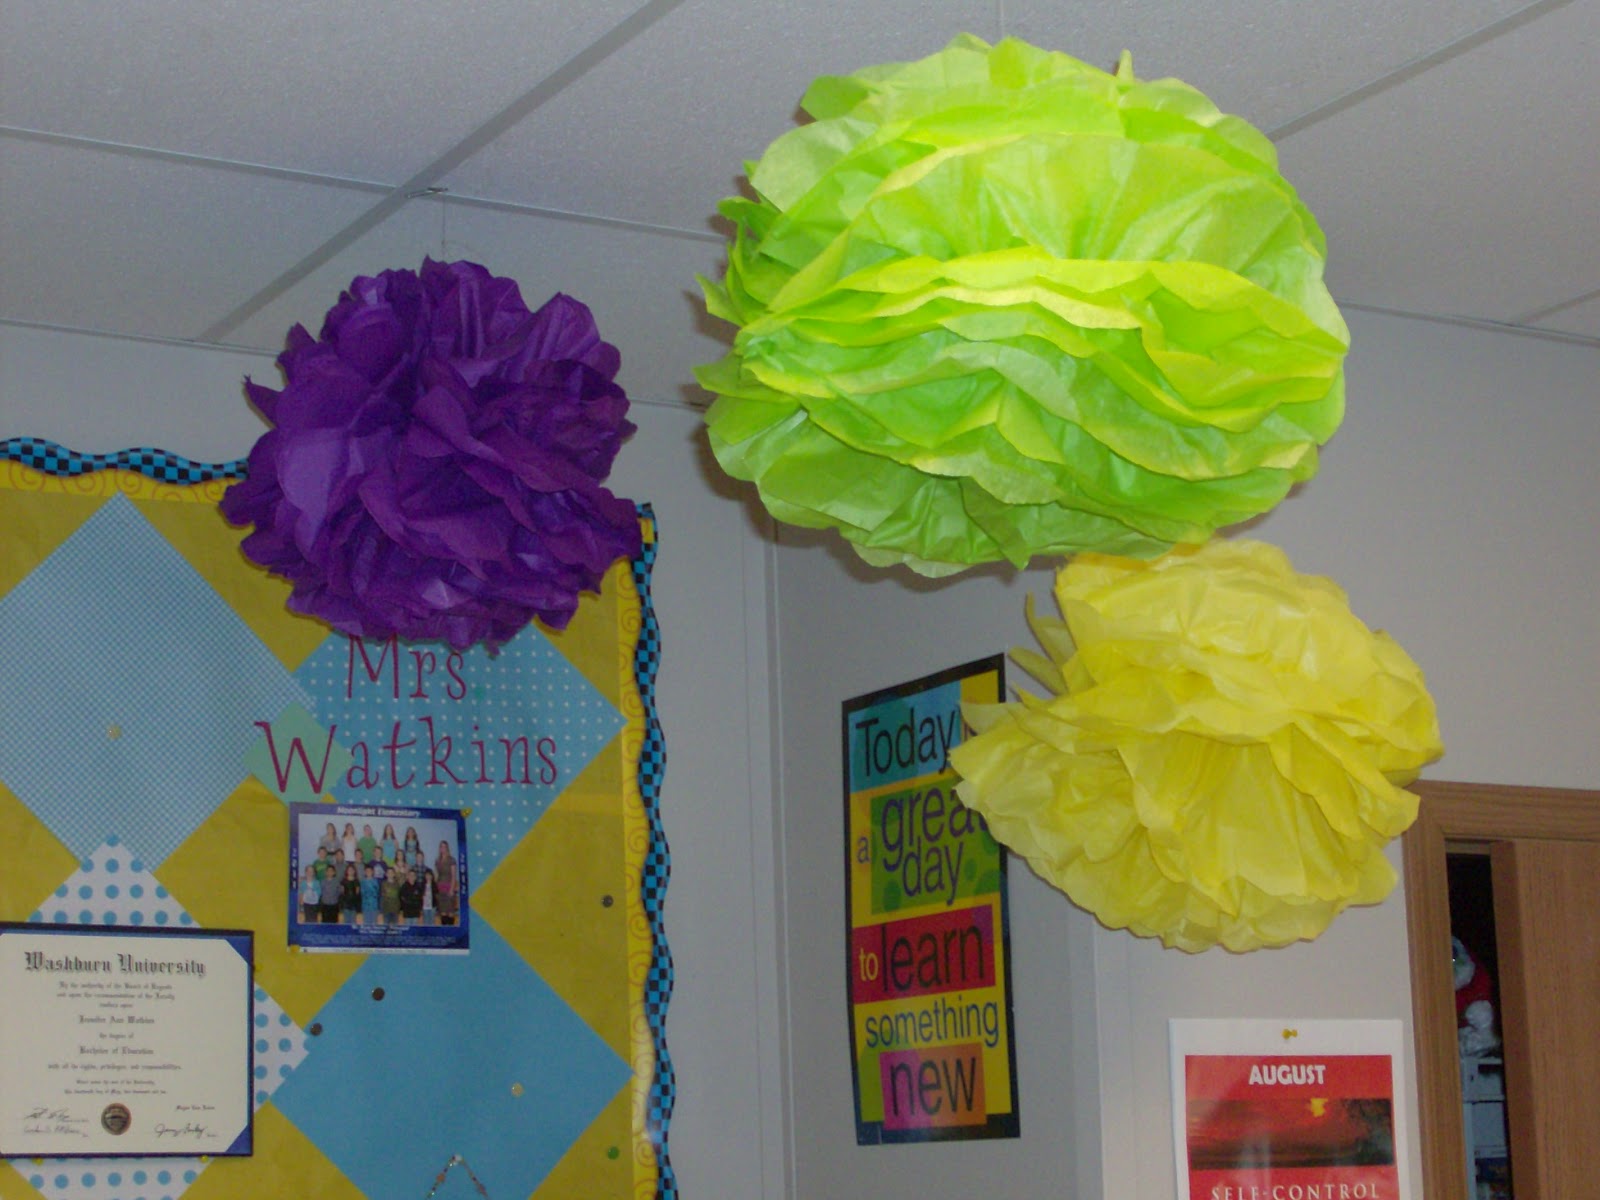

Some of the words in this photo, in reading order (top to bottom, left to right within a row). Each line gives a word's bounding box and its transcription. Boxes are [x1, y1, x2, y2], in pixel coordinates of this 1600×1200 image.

[346, 632, 467, 700] Mrs
[254, 715, 558, 795] Watkins
[855, 708, 956, 777] Today
[856, 836, 870, 864] a
[881, 787, 988, 872] grea
[903, 837, 964, 906] day
[24, 951, 112, 973] Washburn
[117, 953, 207, 978] University
[858, 946, 879, 982] to
[880, 923, 985, 993] learn
[865, 995, 1000, 1048] something
[890, 1057, 976, 1118] new
[1248, 1064, 1327, 1086] AUGUST
[1211, 1182, 1380, 1200] SELF-CONTROL
